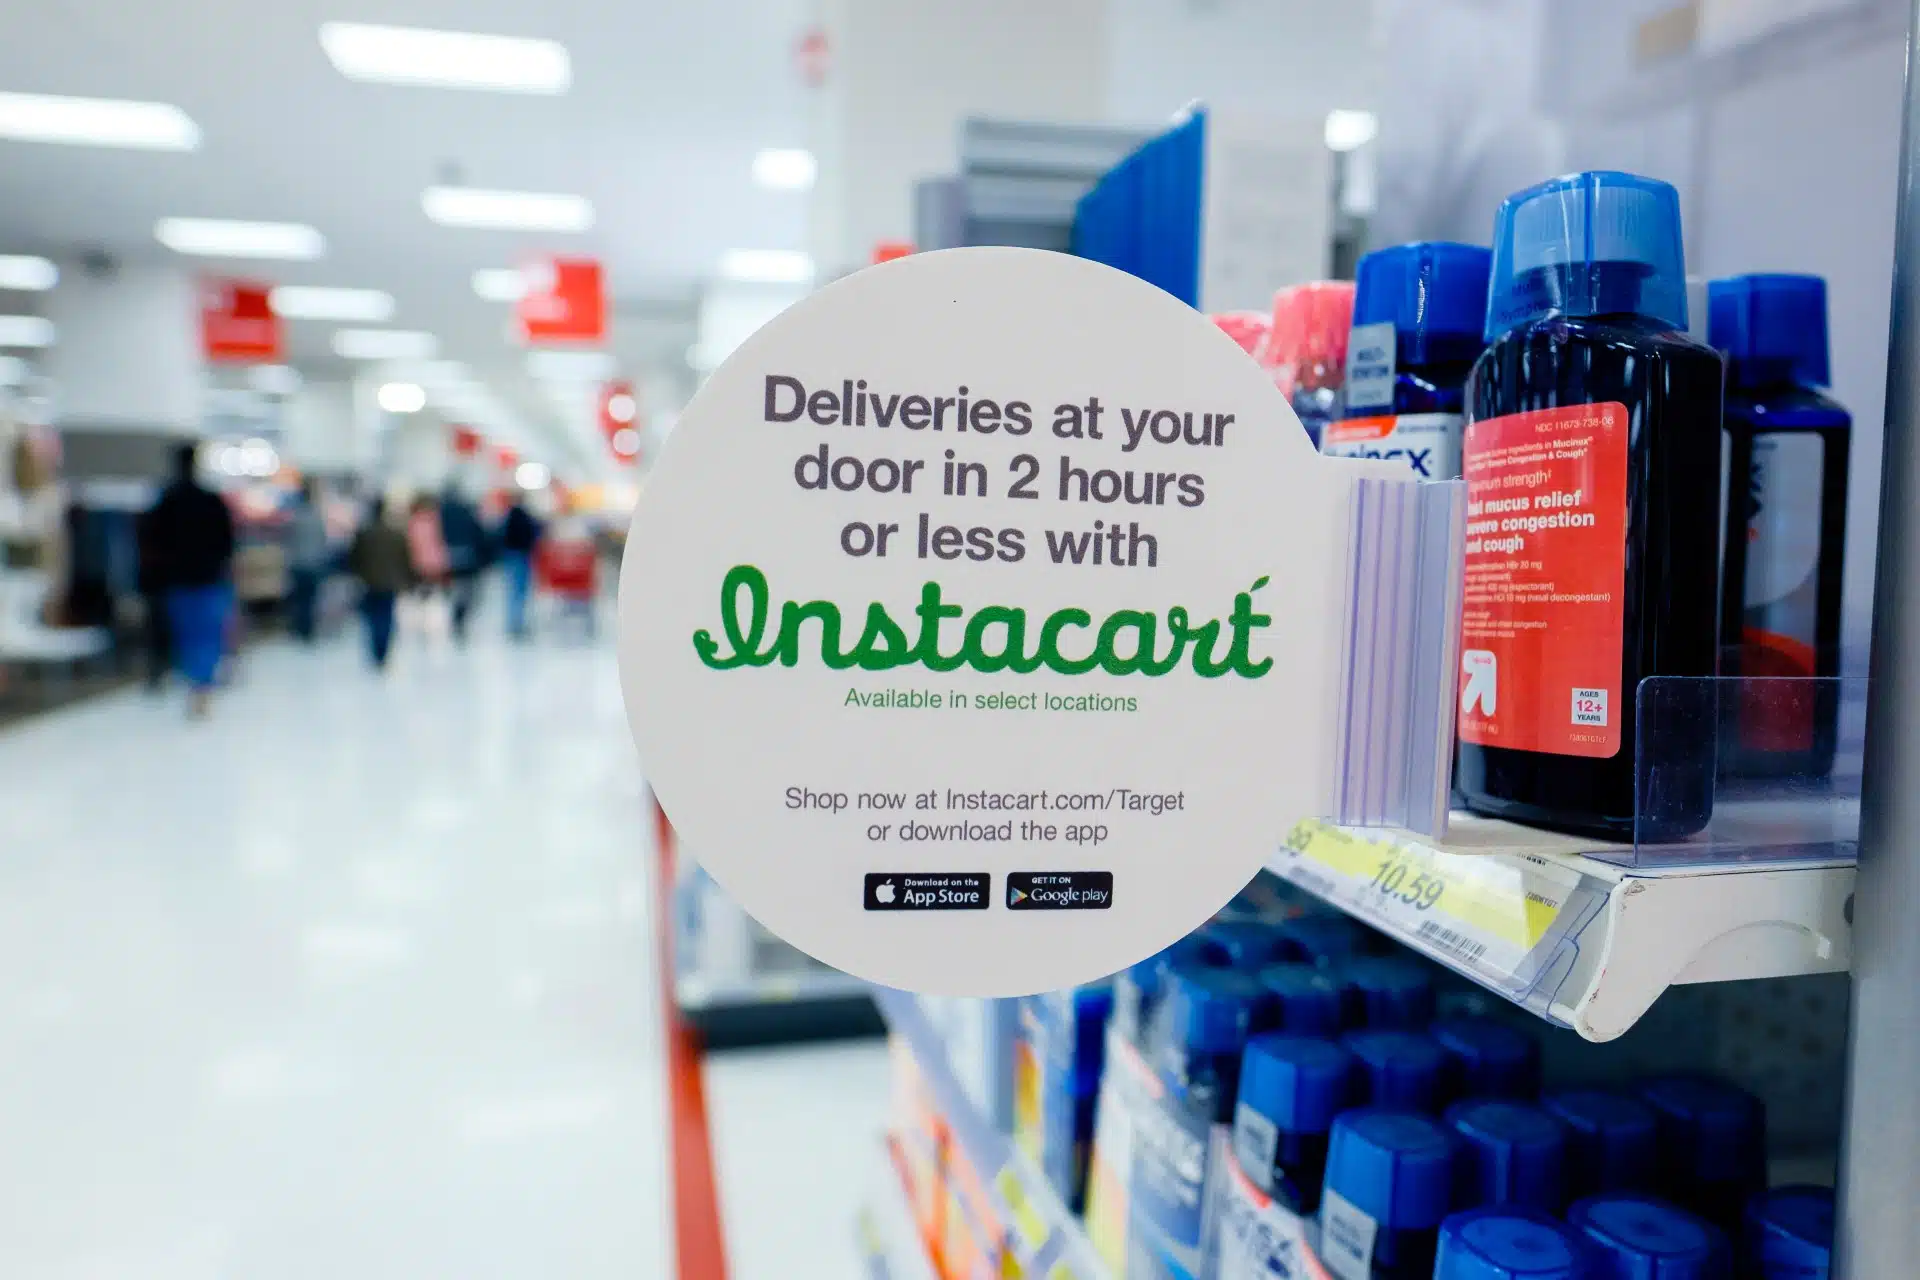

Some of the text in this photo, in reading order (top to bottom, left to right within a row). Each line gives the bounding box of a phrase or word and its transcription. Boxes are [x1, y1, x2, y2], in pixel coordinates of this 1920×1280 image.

[764, 374, 1236, 453] Deliveries at your
[794, 443, 1205, 508] door in 2 hours
[1485, 496, 1530, 513] mucus
[1534, 489, 1583, 509] relief
[1501, 511, 1595, 533] congestion
[840, 512, 1158, 568] or less with
[1484, 534, 1524, 554] cough
[692, 563, 1274, 680] Instacart
[844, 687, 1138, 713] Available in select locations
[1576, 699, 1603, 713] 12+
[1579, 690, 1599, 699] AGES
[1577, 713, 1601, 722] YEARS
[785, 786, 1185, 817] Shop now at Instacart.com/Target
[867, 819, 1109, 847] or download the app
[904, 878, 979, 887] Download on the
[1031, 876, 1071, 885] GET IT ON
[1368, 858, 1445, 911] 10.59
[903, 888, 980, 907] App Store
[1030, 887, 1109, 906] Google play
